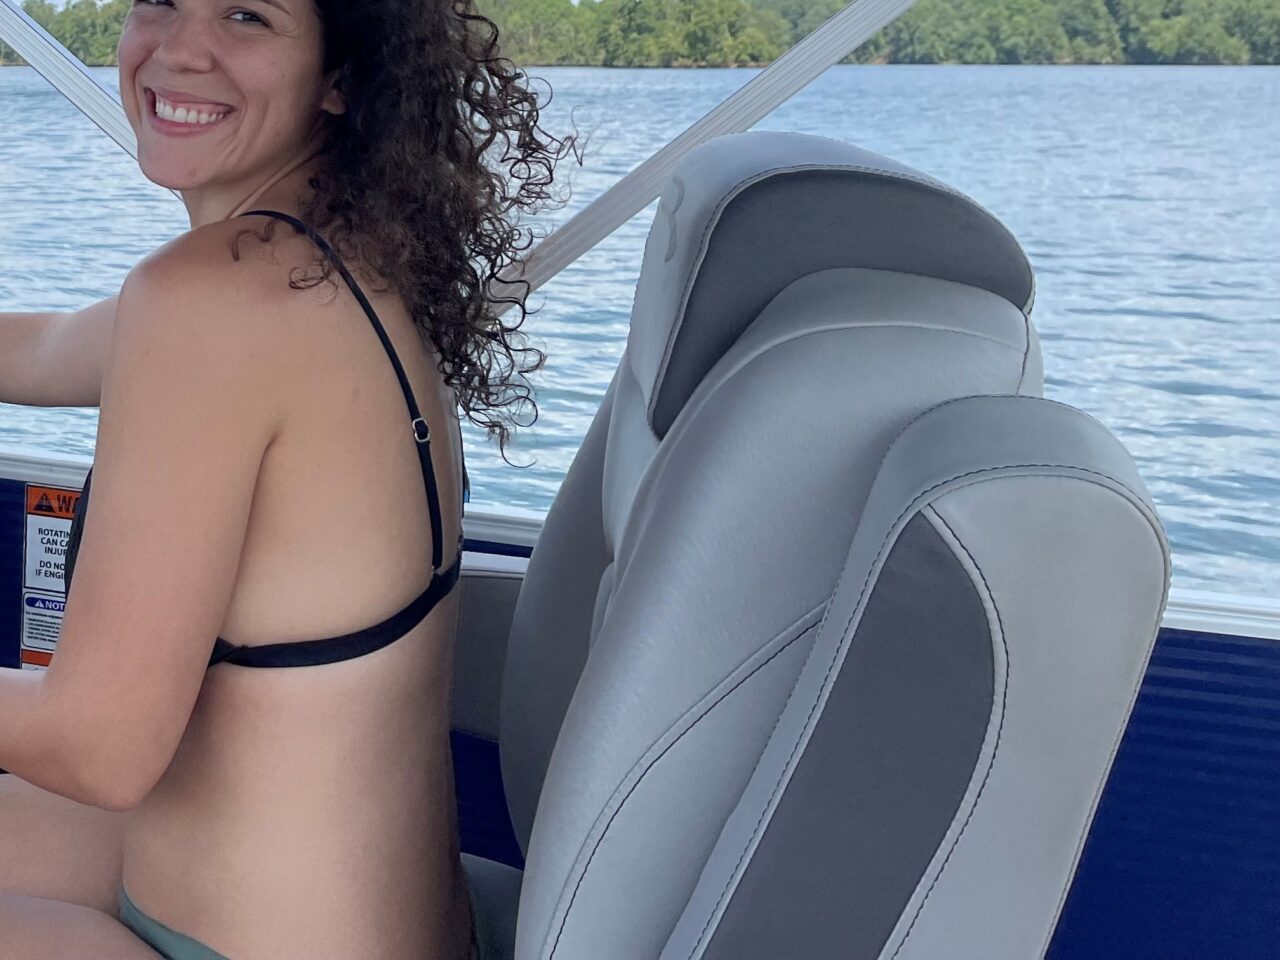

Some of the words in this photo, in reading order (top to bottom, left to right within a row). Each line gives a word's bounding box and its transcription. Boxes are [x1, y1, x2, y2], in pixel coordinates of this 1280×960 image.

[40, 537, 58, 546] CAN
[39, 560, 52, 568] DO
[35, 568, 43, 576] IF
[44, 570, 64, 580] ENGI
[45, 600, 65, 611] NOT
